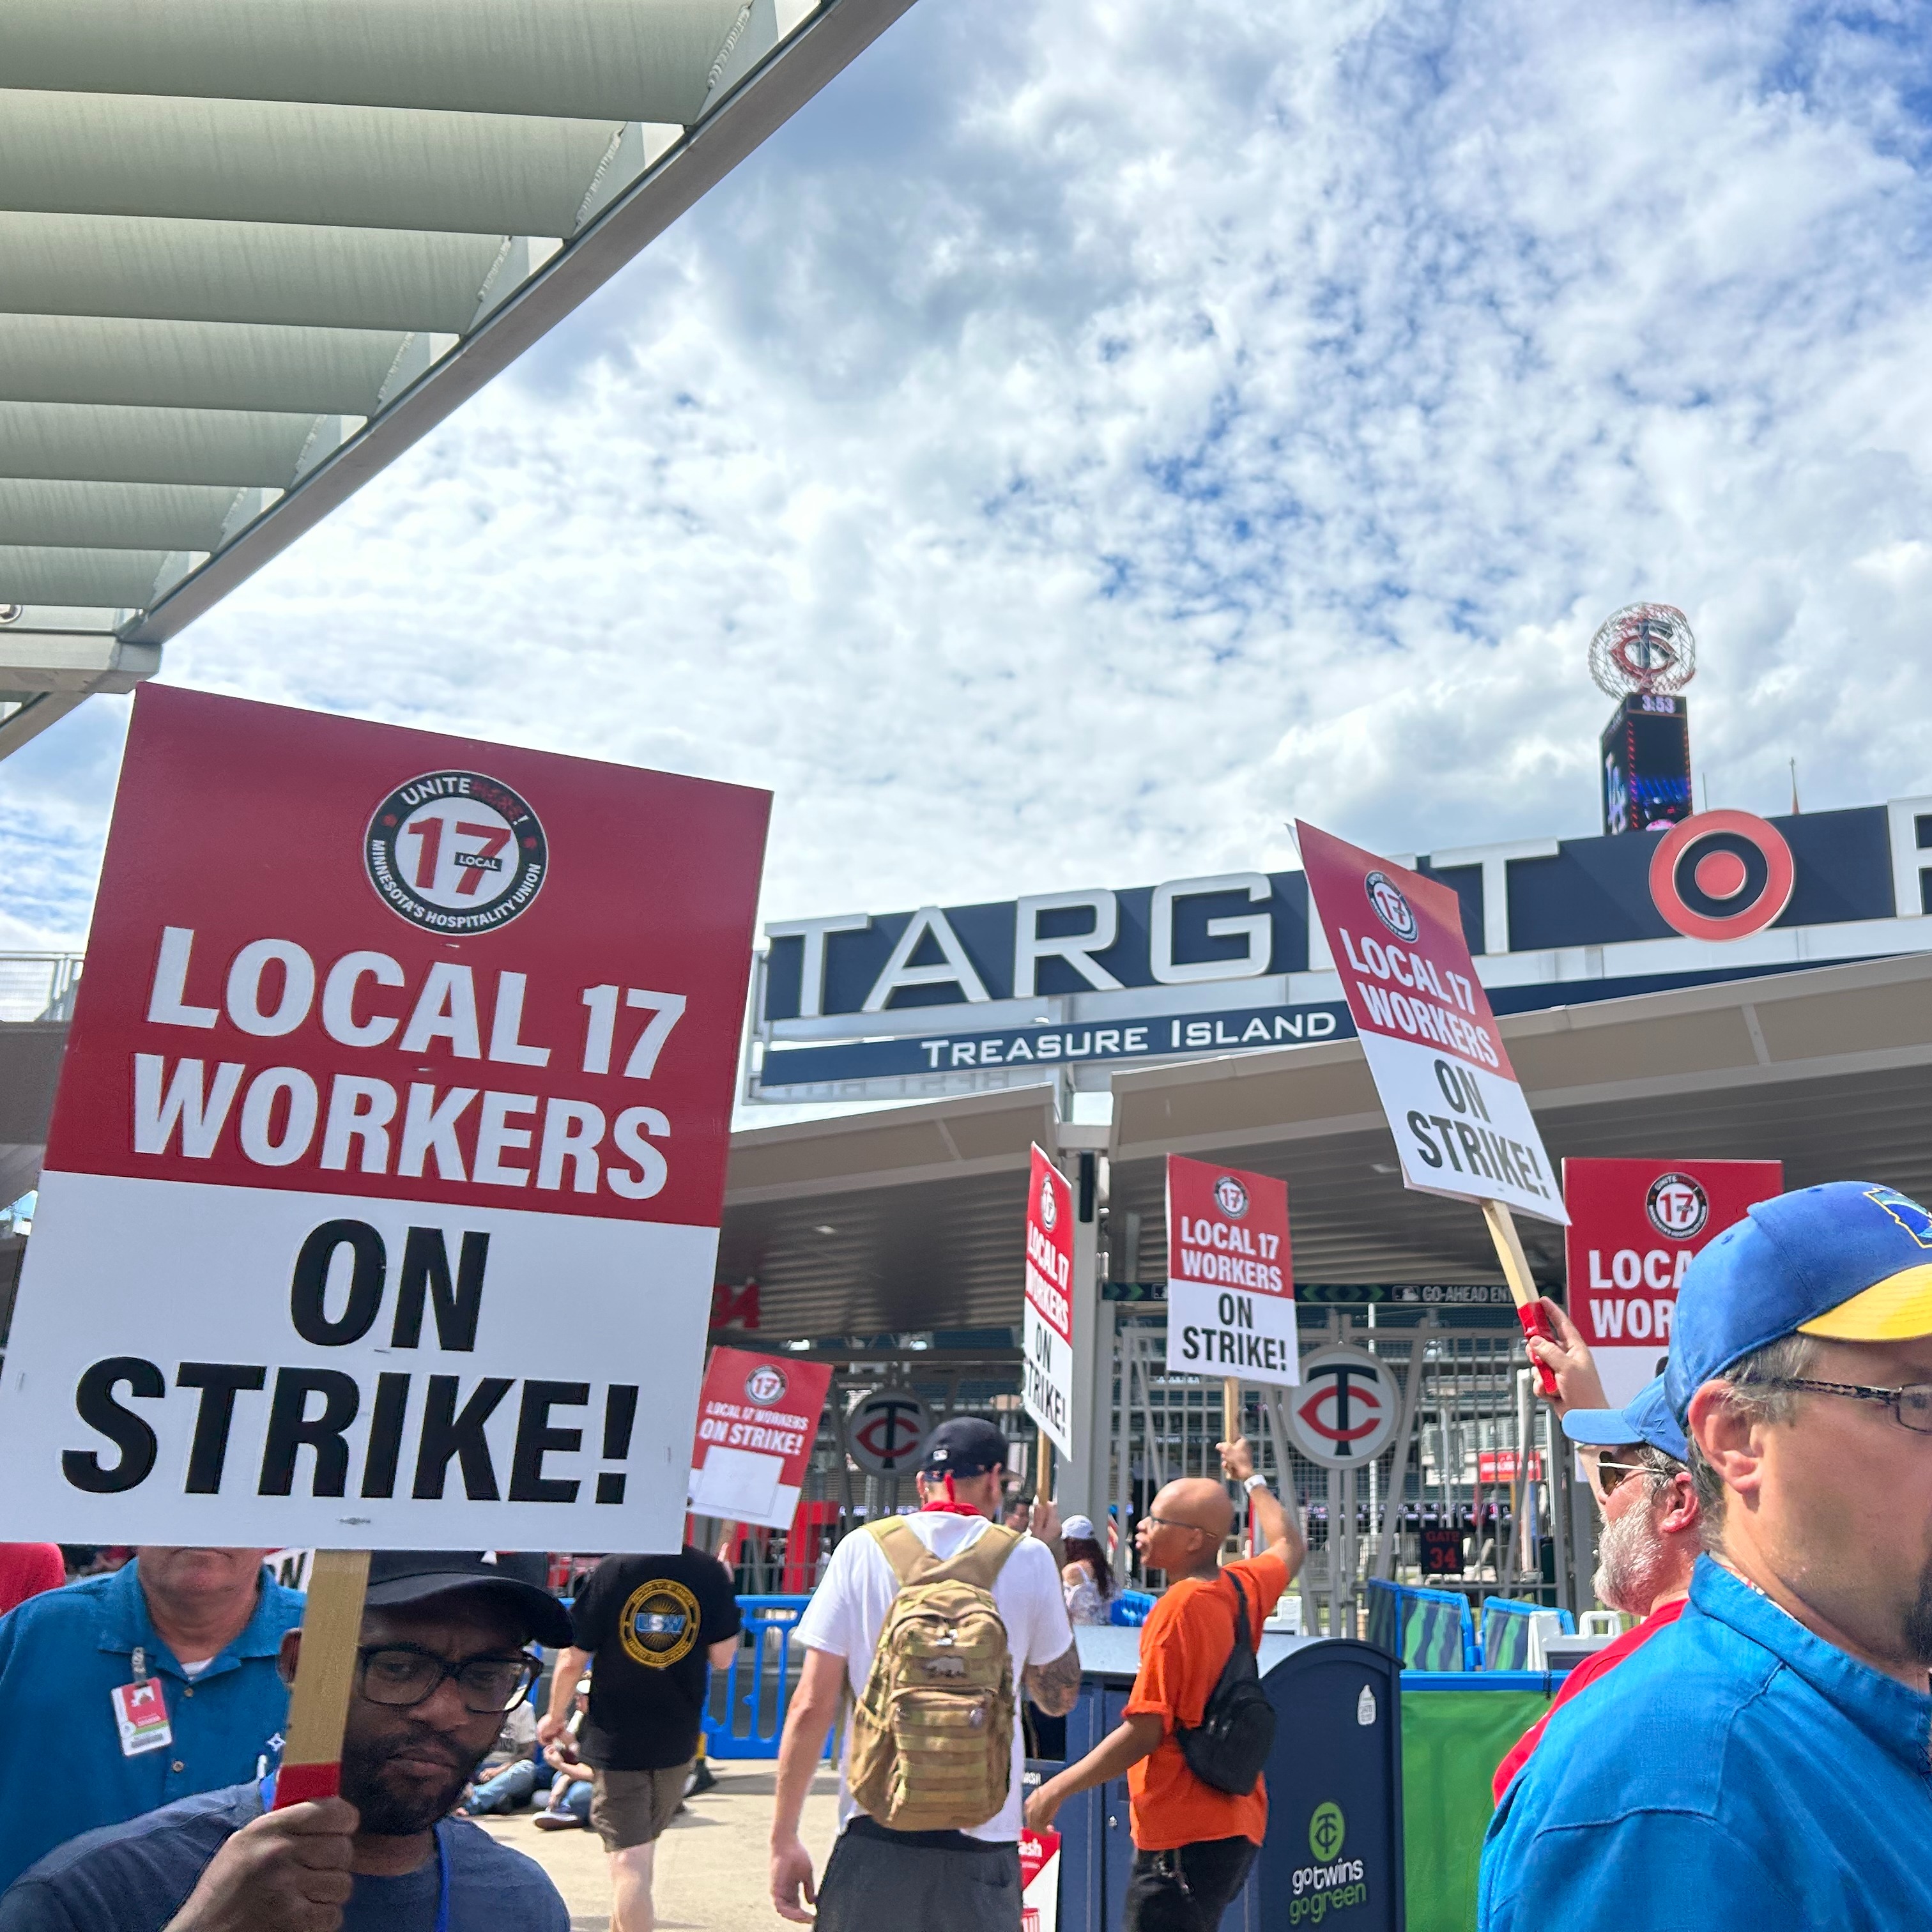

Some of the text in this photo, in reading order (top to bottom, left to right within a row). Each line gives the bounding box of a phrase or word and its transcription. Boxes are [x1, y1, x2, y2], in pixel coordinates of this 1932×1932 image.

[400, 776, 471, 806] UNITE
[408, 816, 512, 896] 17
[459, 854, 497, 870] LOCAL
[371, 839, 542, 928] MINNESOTA'S HOSPITALITY UNION
[765, 836, 1560, 1017] TARGT
[1339, 927, 1476, 1016] LOCAL 17
[147, 925, 687, 1080] LOCAL 17
[1357, 981, 1500, 1070] WORKERS
[1434, 1059, 1492, 1125] ON
[133, 1052, 671, 1200] WORKERS
[1406, 1109, 1552, 1200] STRIKE!
[1660, 1192, 1694, 1223] 17
[1027, 1218, 1058, 1282] LOCAL
[1181, 1216, 1280, 1261] LOCAL 17
[291, 1218, 491, 1353] ON
[1181, 1249, 1284, 1293] WORKERS
[1588, 1249, 1694, 1289] LOCA
[1218, 1292, 1255, 1330] ON
[1422, 1285, 1489, 1303] GO-AHEAD
[1035, 1321, 1053, 1374] ON
[1181, 1326, 1287, 1372] STRIKE!
[61, 1356, 639, 1506] STRIKE!
[706, 1400, 741, 1420] LOCAL
[699, 1418, 806, 1456] ON STRIKE!
[1425, 1531, 1460, 1543] GATE
[1429, 1546, 1457, 1569] 34
[635, 1612, 687, 1635] USW
